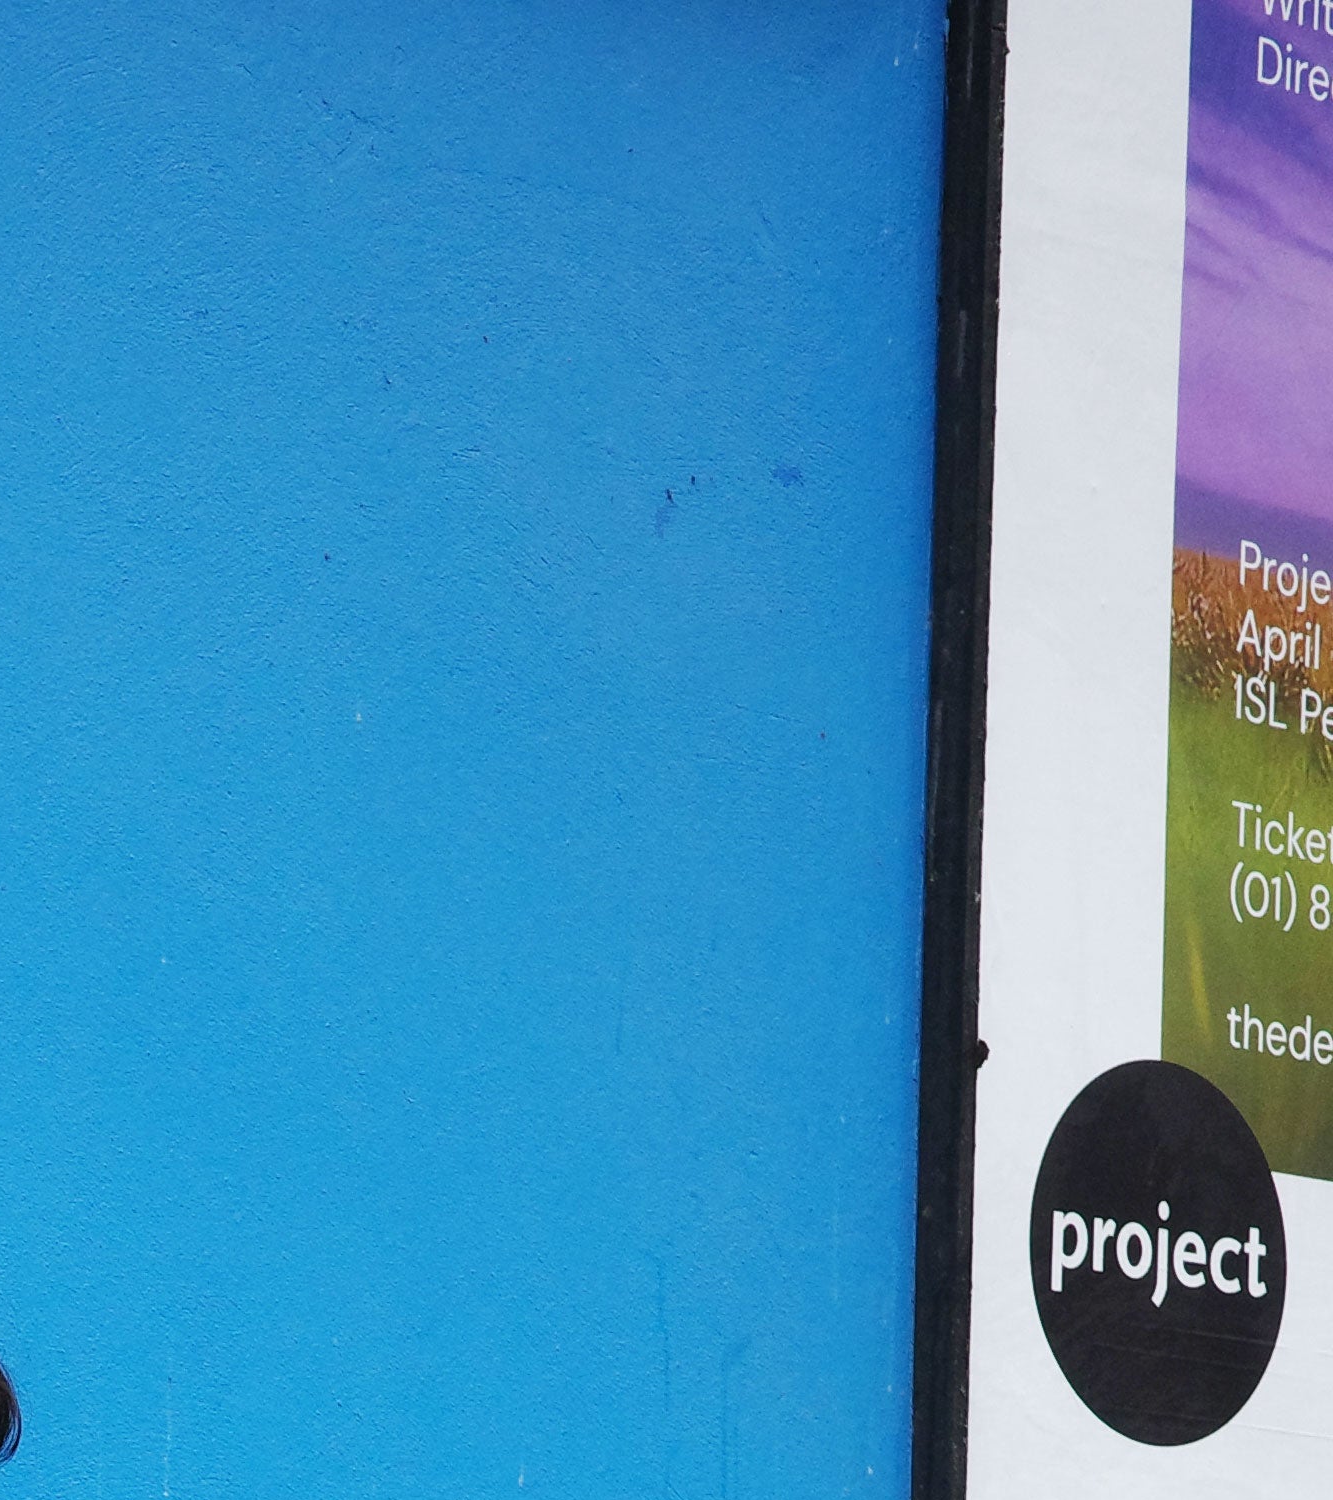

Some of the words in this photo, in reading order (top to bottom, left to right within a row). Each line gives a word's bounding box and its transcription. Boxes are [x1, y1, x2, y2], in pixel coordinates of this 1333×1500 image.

[1257, 35, 1333, 102] Dire
[1239, 539, 1332, 614] Proje
[1236, 608, 1321, 673] April
[1230, 860, 1297, 932] (01)
[1226, 1003, 1333, 1066] thede
[1050, 1200, 1268, 1309] project
